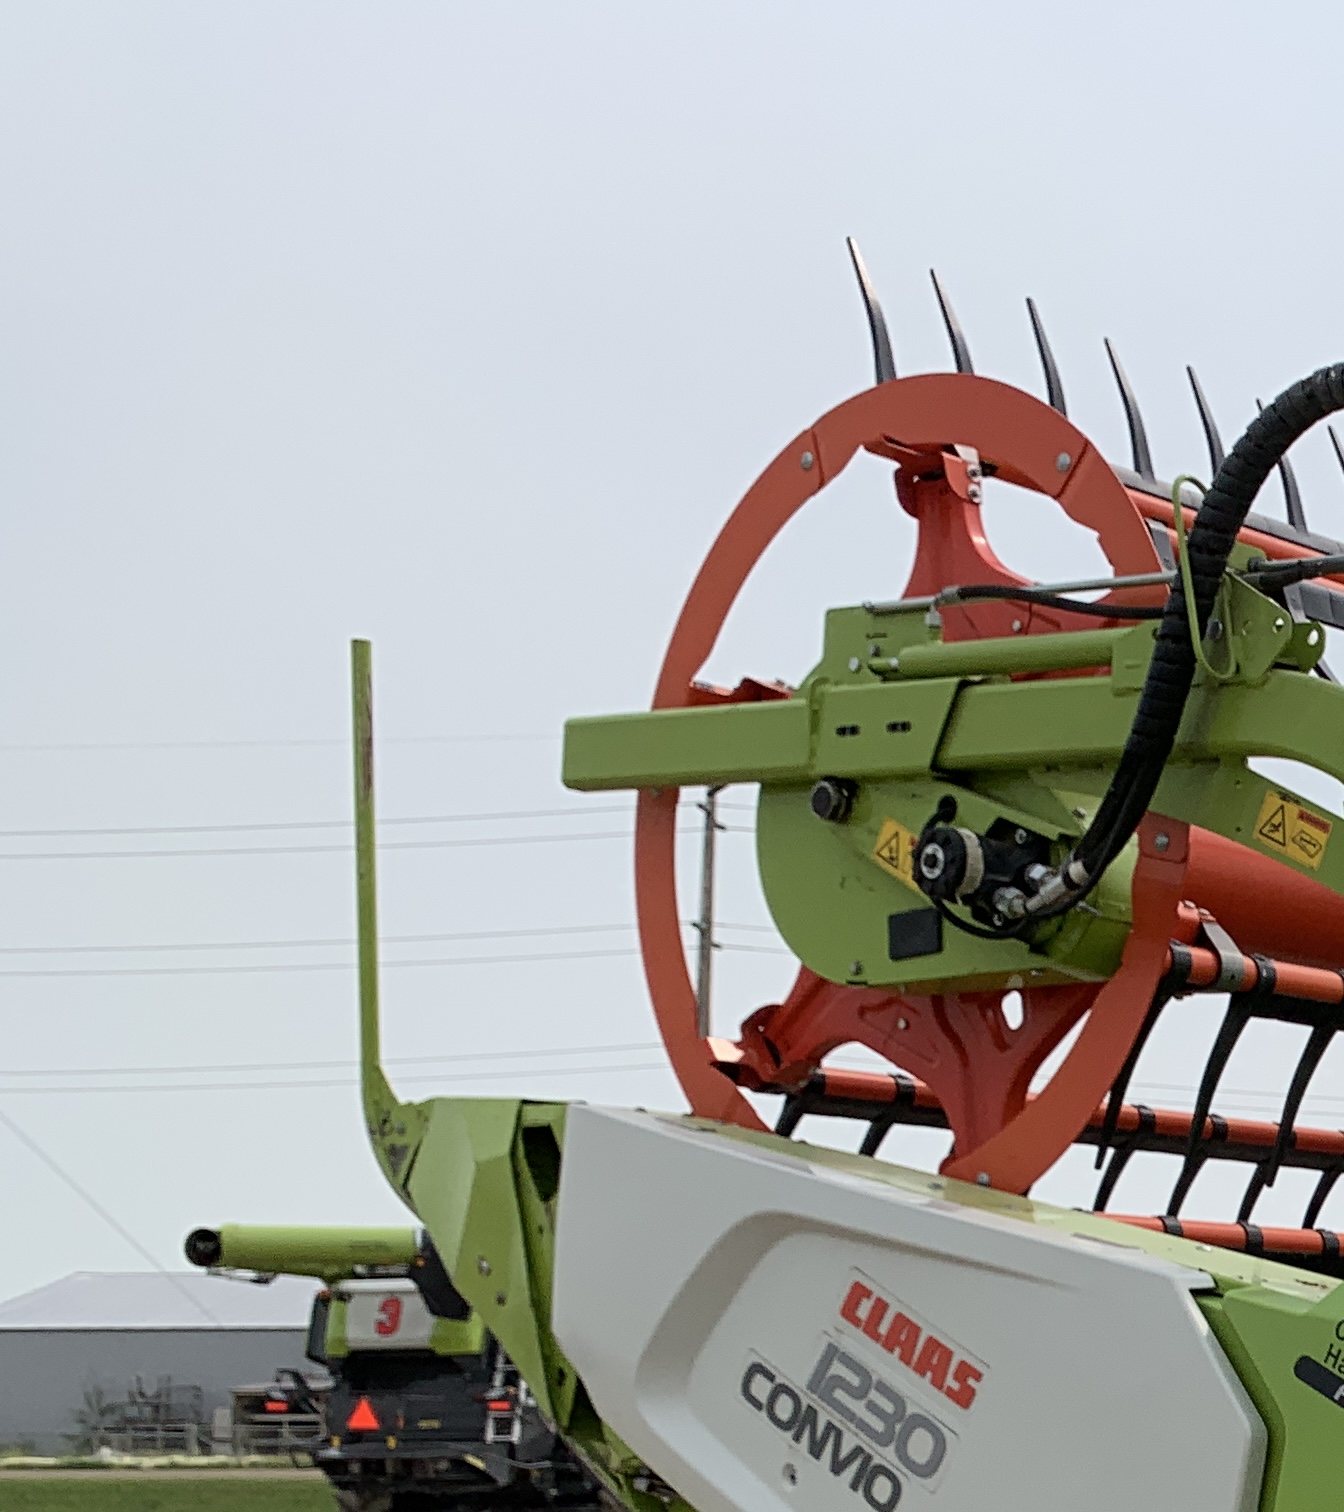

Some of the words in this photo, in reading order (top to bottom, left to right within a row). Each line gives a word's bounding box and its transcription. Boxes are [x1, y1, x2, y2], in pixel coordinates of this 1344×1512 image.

[375, 1296, 402, 1335] 3
[839, 1280, 984, 1411] CLAAS
[806, 1341, 947, 1480] 1230
